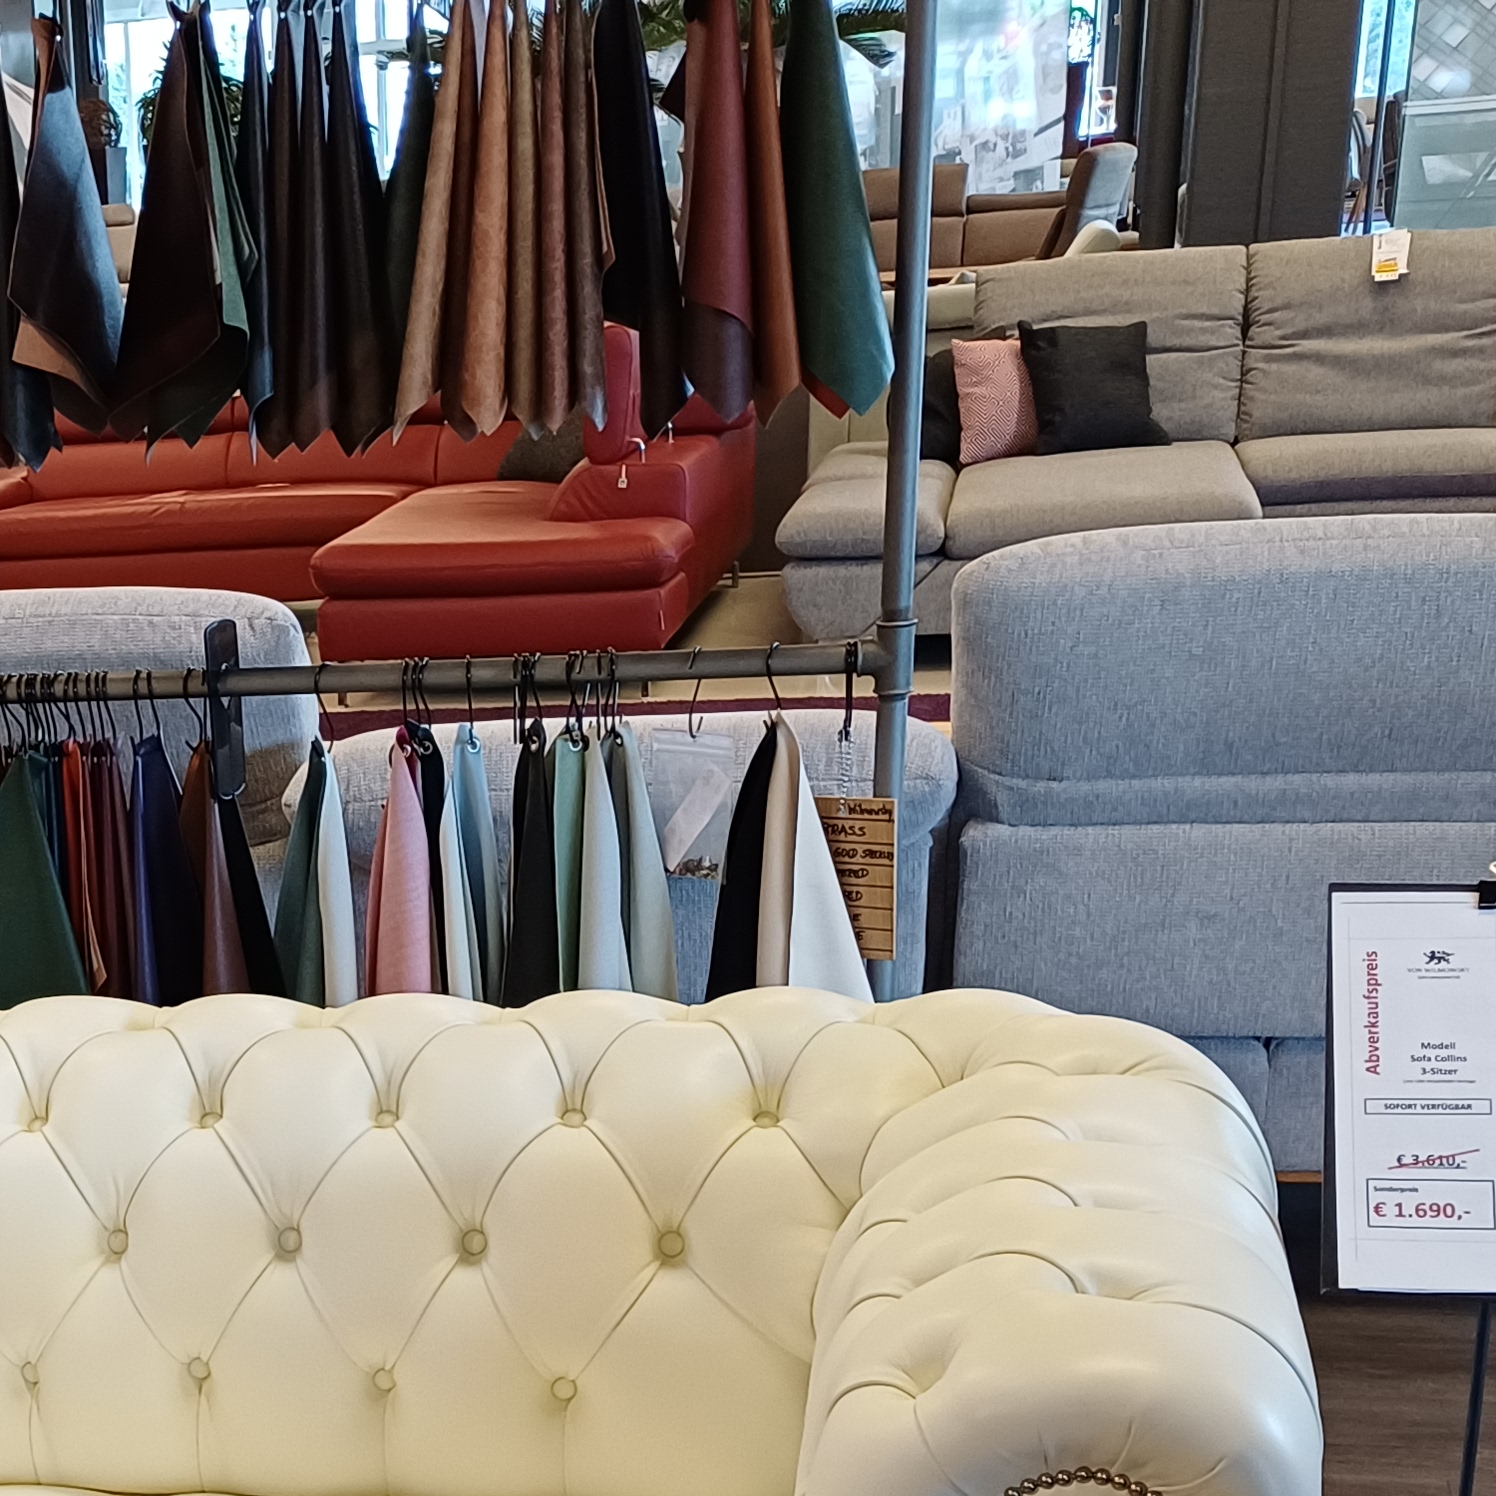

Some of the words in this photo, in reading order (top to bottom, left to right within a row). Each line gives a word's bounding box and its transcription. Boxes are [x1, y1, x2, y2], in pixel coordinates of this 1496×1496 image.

[1361, 950, 1383, 1076] Abverkaufspreis
[1420, 1042, 1456, 1050] Modell
[1410, 1054, 1432, 1062] Sofa
[1434, 1054, 1468, 1062] Collins
[1420, 1067, 1459, 1075] 3-Sitzer
[1420, 1102, 1473, 1110] VERFÜGBAR
[1396, 1153, 1406, 1166] €
[1373, 1202, 1387, 1217] €
[1394, 1202, 1472, 1220] 1.690,-
